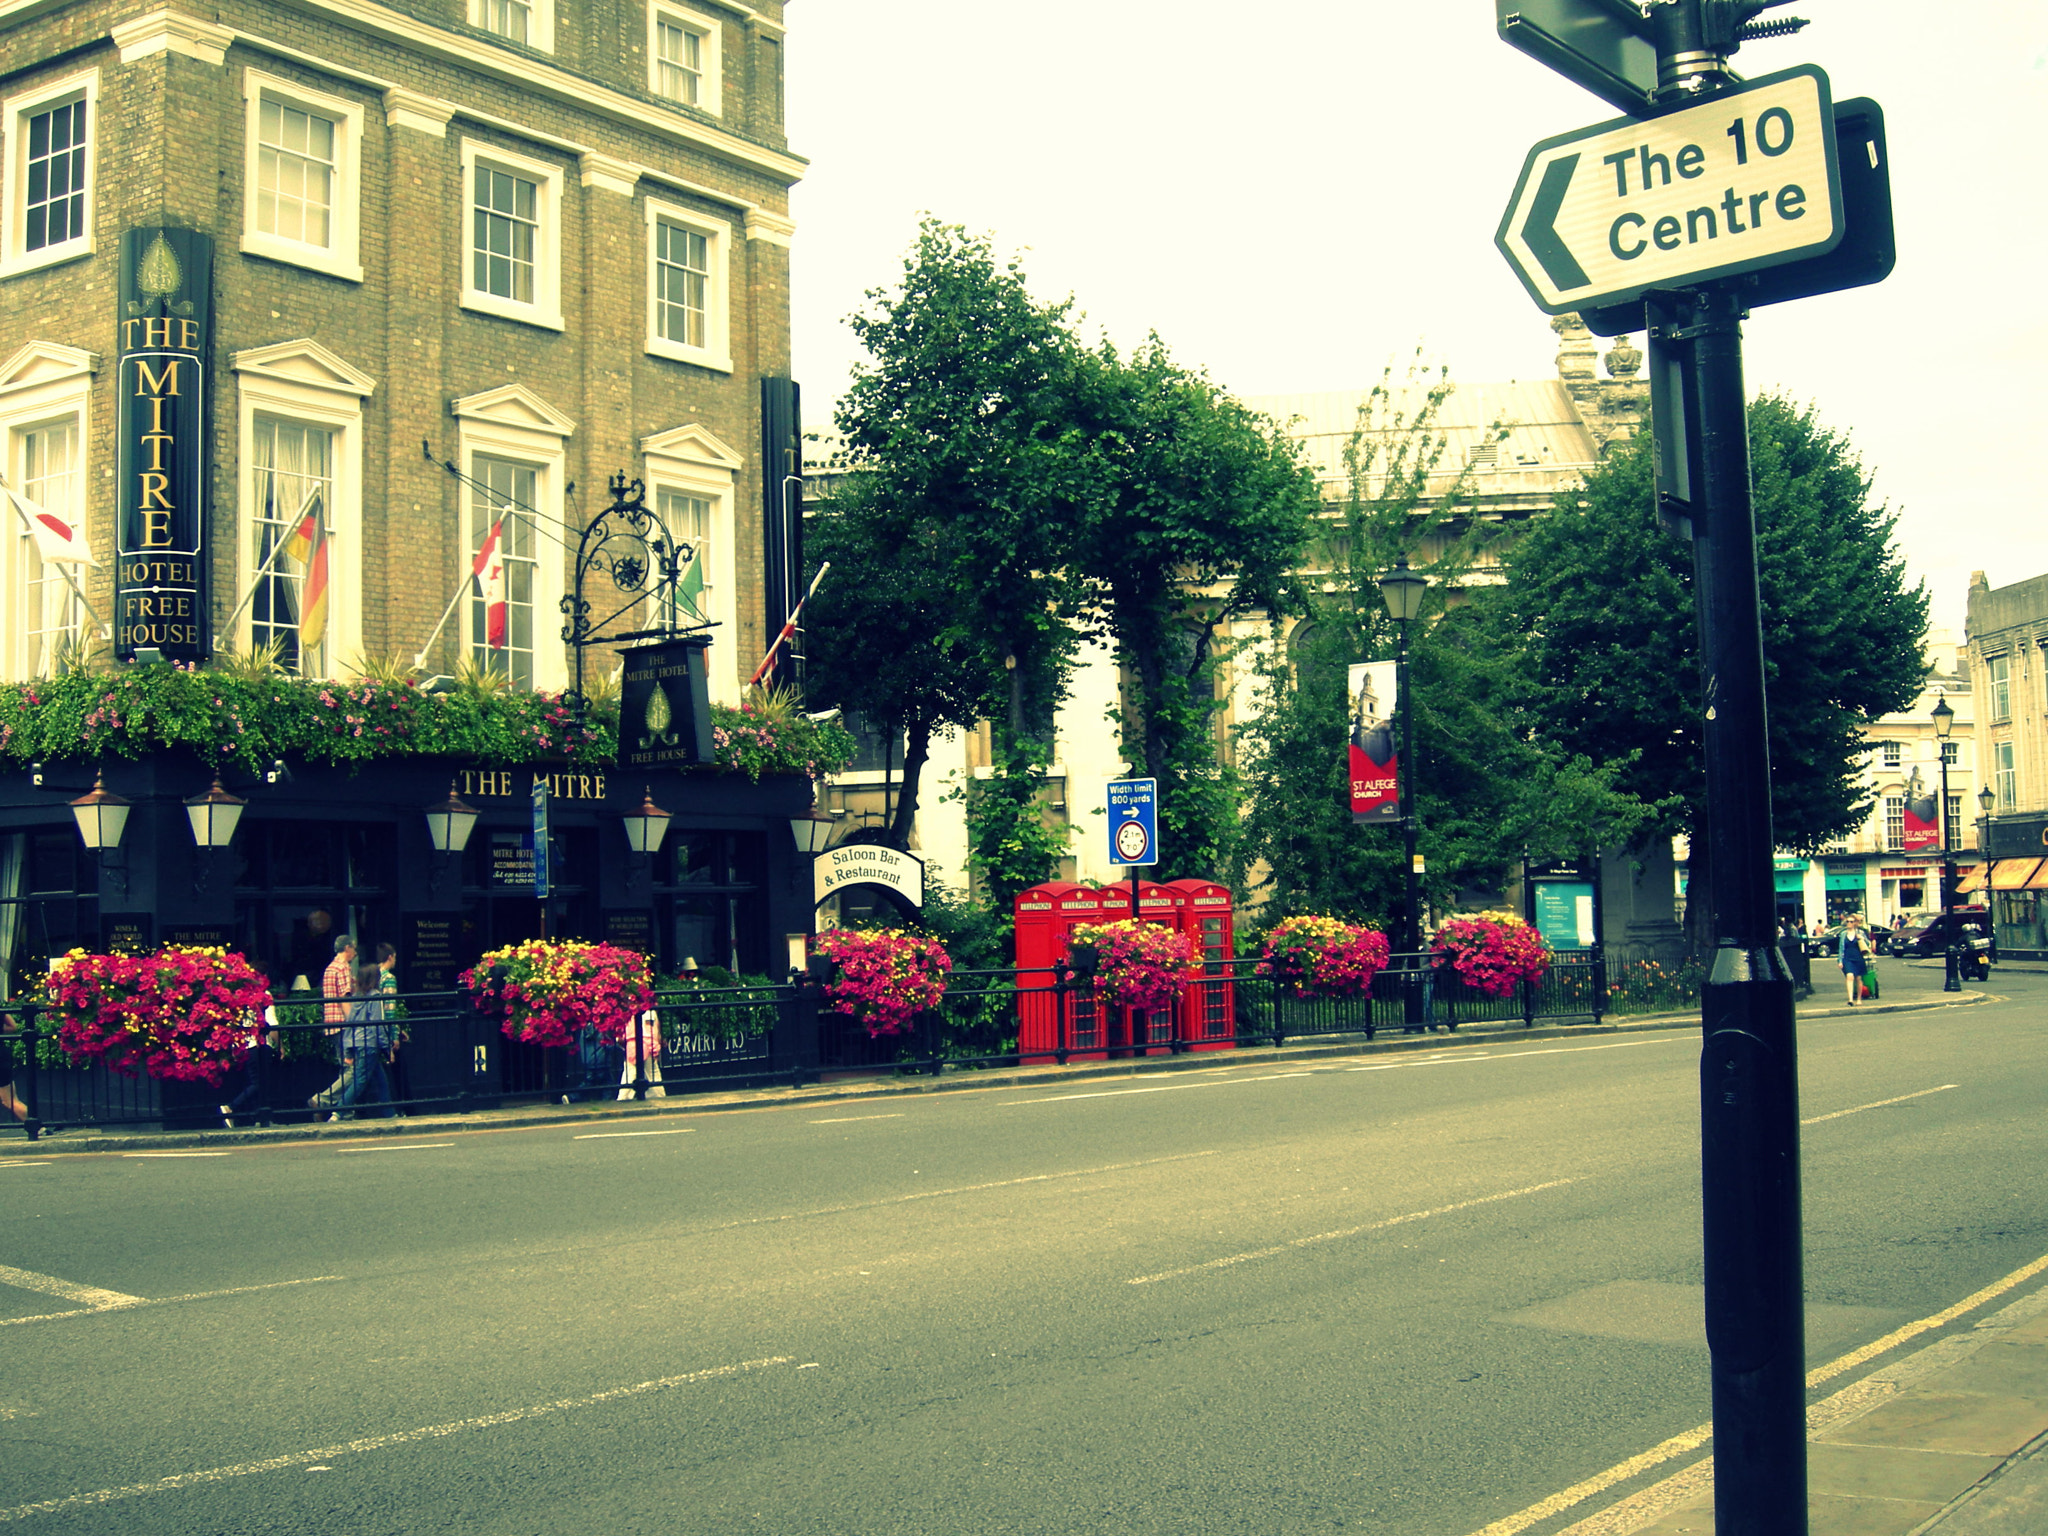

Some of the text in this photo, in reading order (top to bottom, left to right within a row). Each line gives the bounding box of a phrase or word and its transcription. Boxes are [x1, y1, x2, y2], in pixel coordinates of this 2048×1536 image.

[1603, 106, 1794, 198] The 10
[1608, 183, 1807, 260] Centre
[121, 317, 200, 351] THE
[134, 360, 182, 547] MITRE
[120, 562, 197, 584] HOTEL
[126, 597, 190, 616] FREE
[119, 624, 198, 645] HOUSE
[648, 655, 666, 666] THE
[626, 664, 689, 682] MITRE HOTEL
[631, 748, 687, 764] FREE HOUSE
[459, 769, 606, 799] THE MITRE
[1109, 783, 1152, 794] Width limit
[1352, 778, 1396, 791] ST ALFEGE
[1111, 794, 1151, 805] 800 yards
[1915, 829, 1938, 837] ALFEGE
[493, 849, 534, 858] MITRE HOTE
[831, 849, 900, 866] Saloon Bar
[824, 866, 901, 886] & Restaurant
[416, 919, 450, 928] Welcome
[174, 932, 221, 940] THE MITRE
